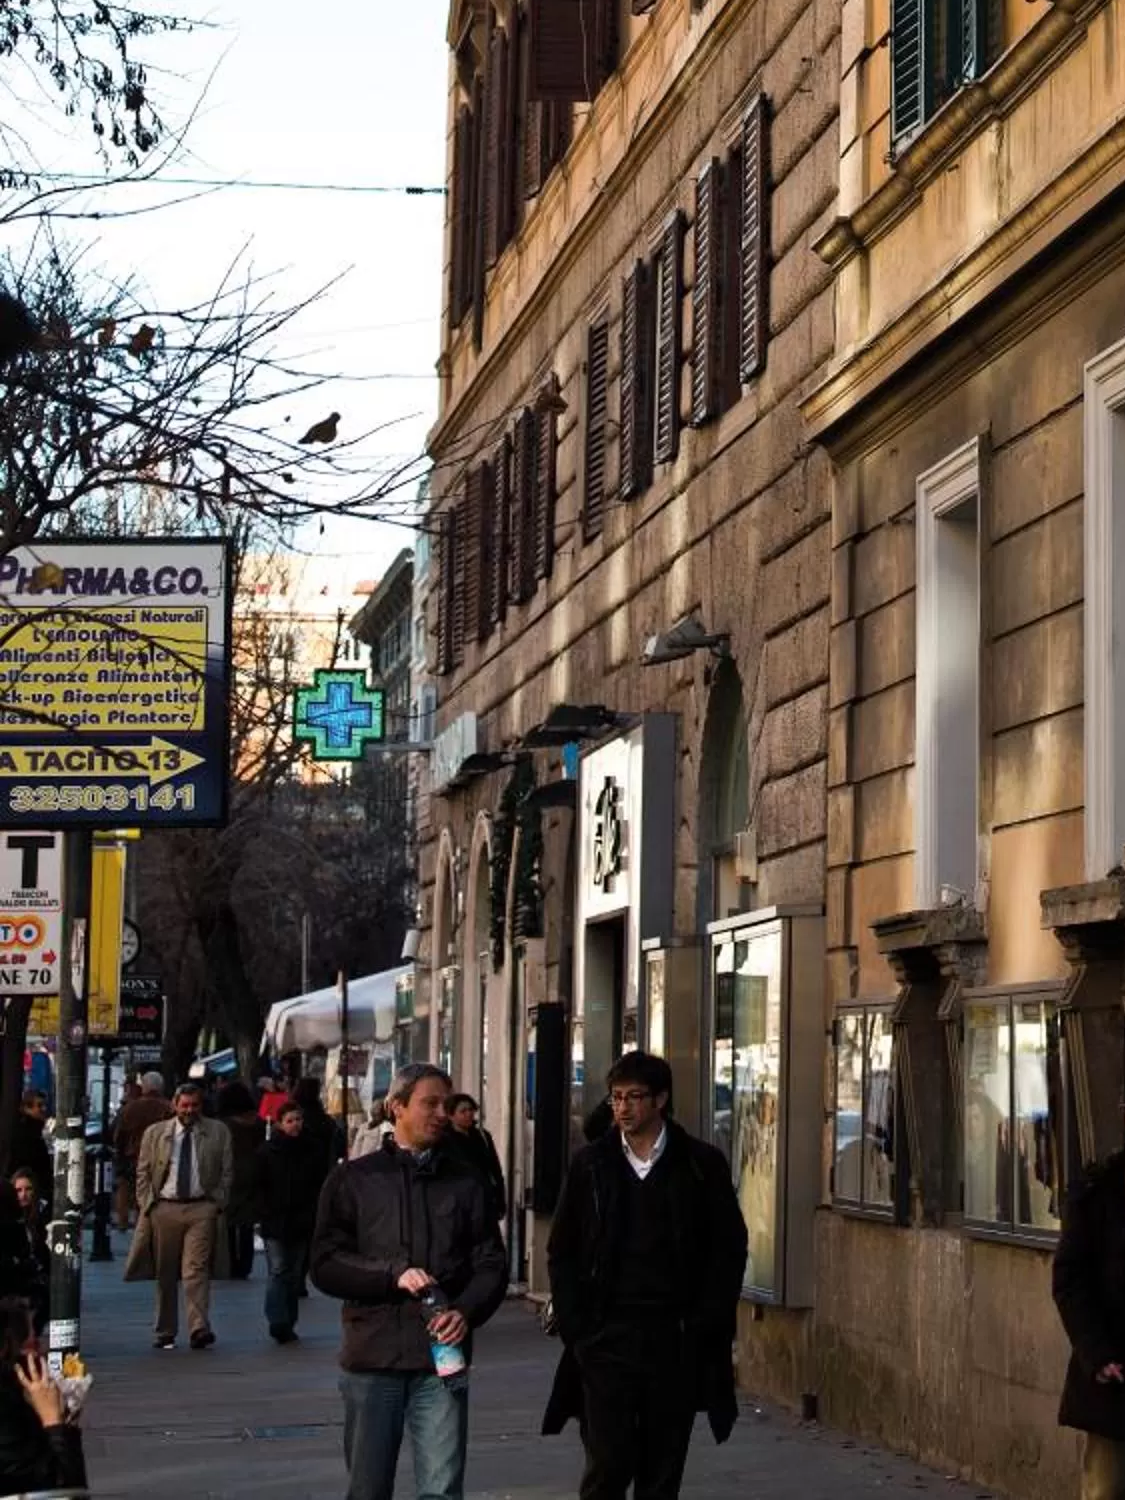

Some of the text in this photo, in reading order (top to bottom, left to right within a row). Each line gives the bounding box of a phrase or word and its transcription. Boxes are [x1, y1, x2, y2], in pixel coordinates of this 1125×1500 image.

[0, 555, 208, 595] PHRMA&CO.
[108, 709, 191, 725] Plantare
[24, 751, 139, 772] TACITO
[147, 752, 180, 771] 13
[9, 783, 195, 812] 32503141
[7, 836, 55, 888] T
[28, 968, 52, 985] 70
